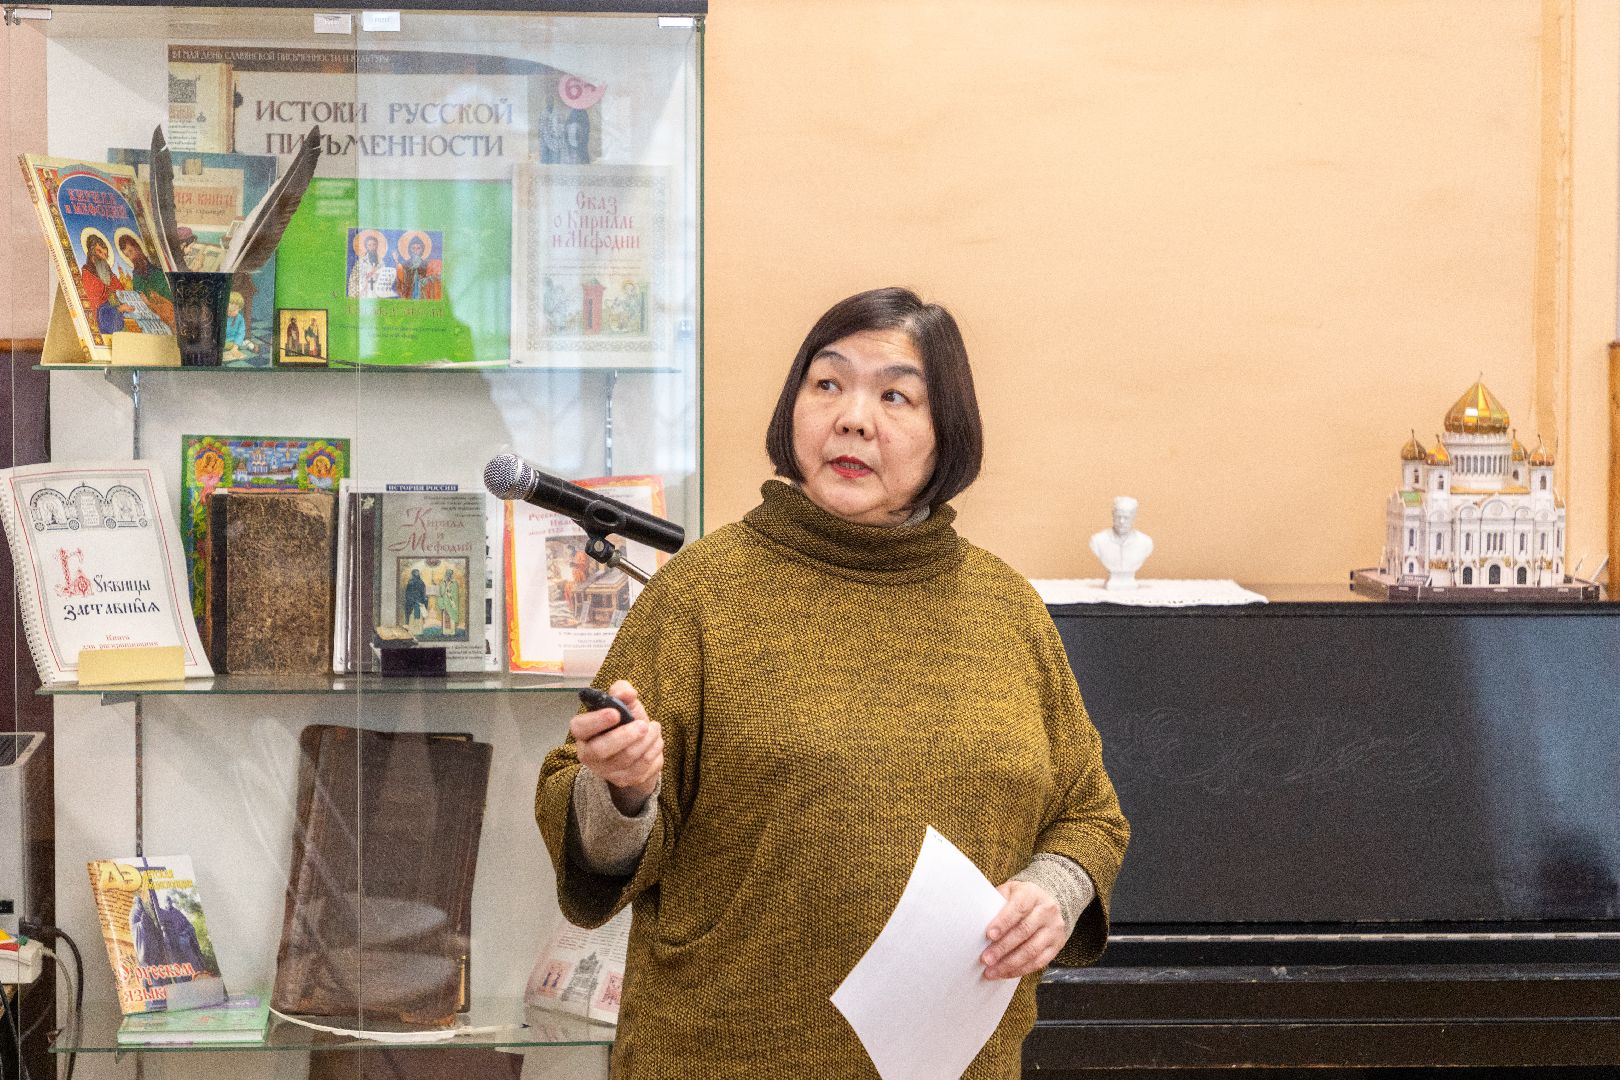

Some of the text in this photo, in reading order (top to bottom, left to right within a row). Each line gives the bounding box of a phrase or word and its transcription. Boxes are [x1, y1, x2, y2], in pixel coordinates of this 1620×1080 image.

[255, 98, 513, 125] ИСТОКИ РУССКОЙ
[576, 190, 618, 214] Сказ
[553, 209, 635, 232] о Кирилле
[387, 532, 474, 554] Мефодий
[135, 962, 195, 986] русском
[123, 986, 166, 1002] язык
